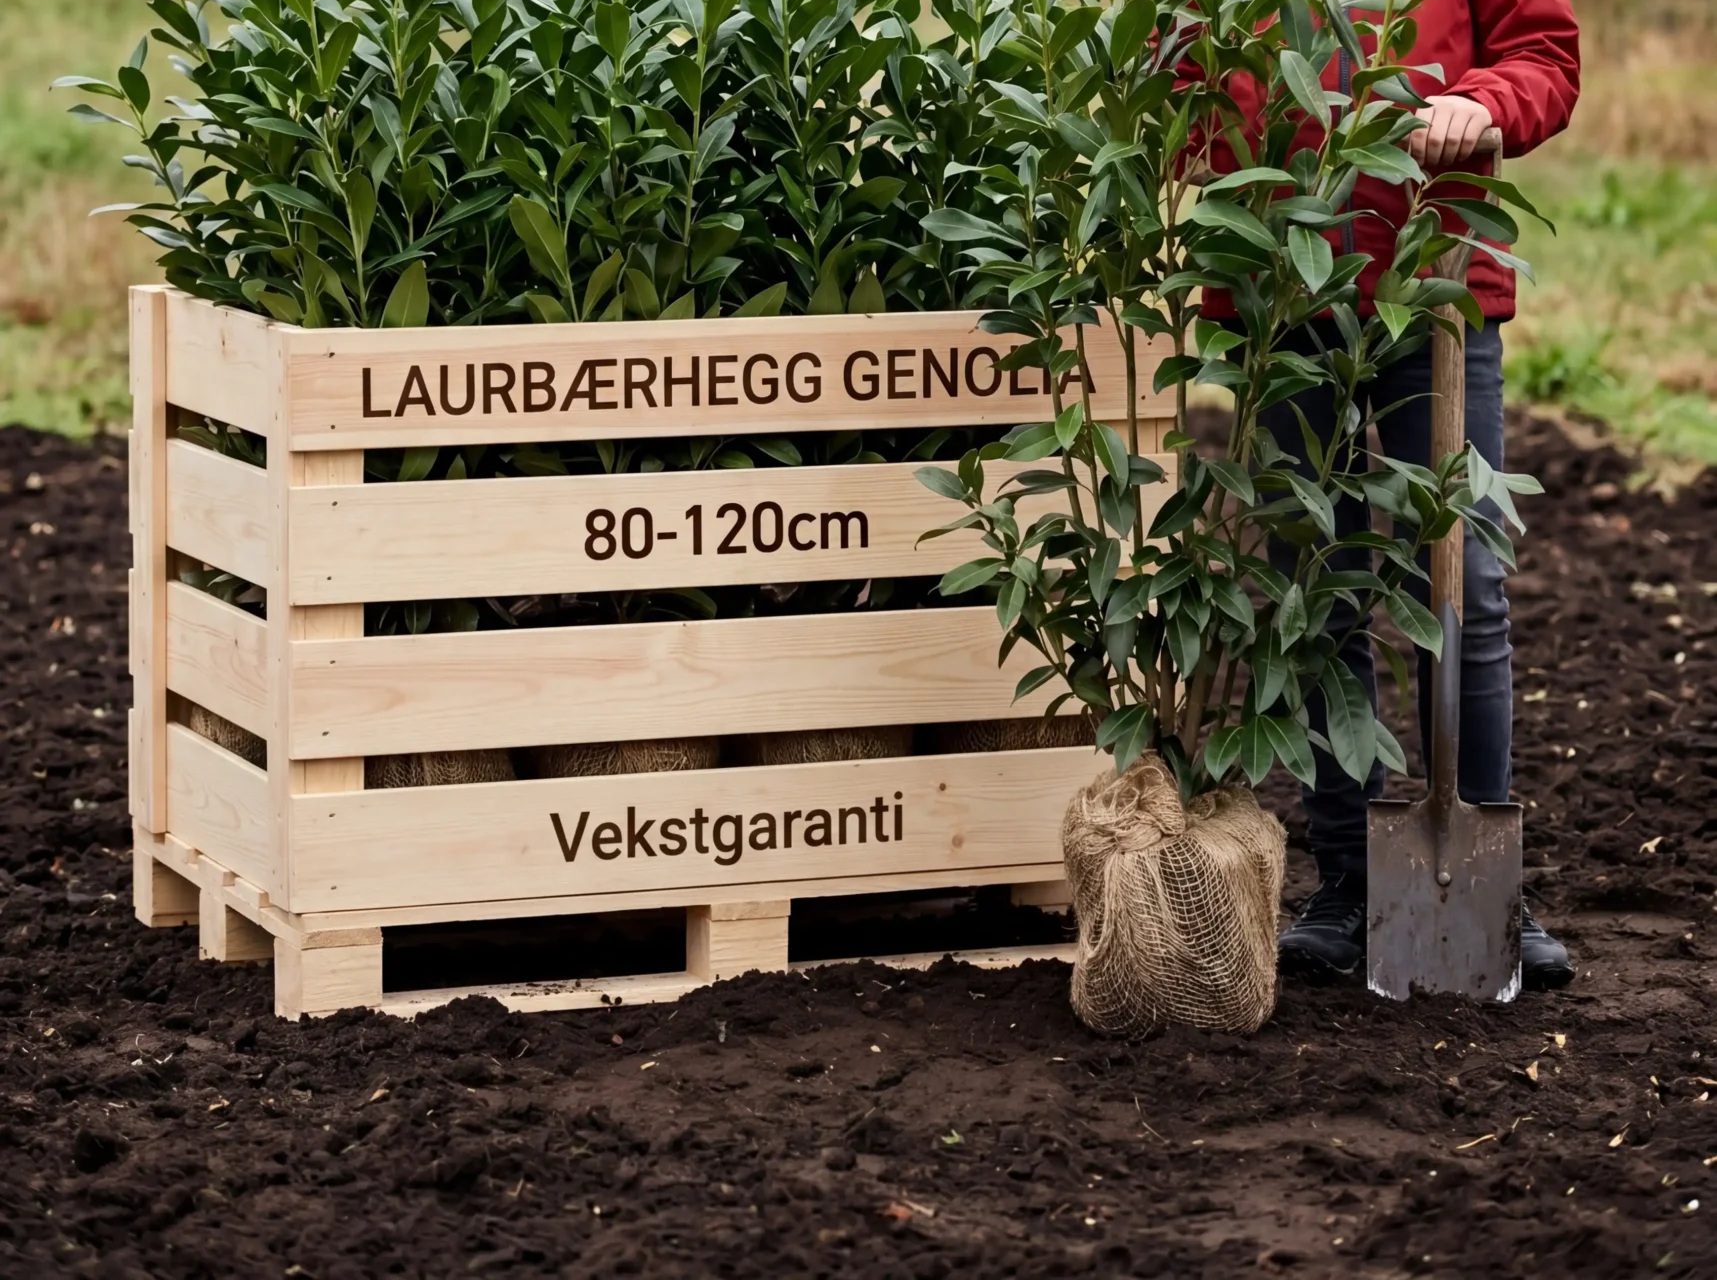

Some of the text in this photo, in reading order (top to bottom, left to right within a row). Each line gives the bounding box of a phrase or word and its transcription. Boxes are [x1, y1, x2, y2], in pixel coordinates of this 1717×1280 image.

[362, 352, 823, 418] LAURBÆRHEGG
[584, 501, 869, 560] 80-120cm
[549, 791, 904, 866] Vekstgaranti
